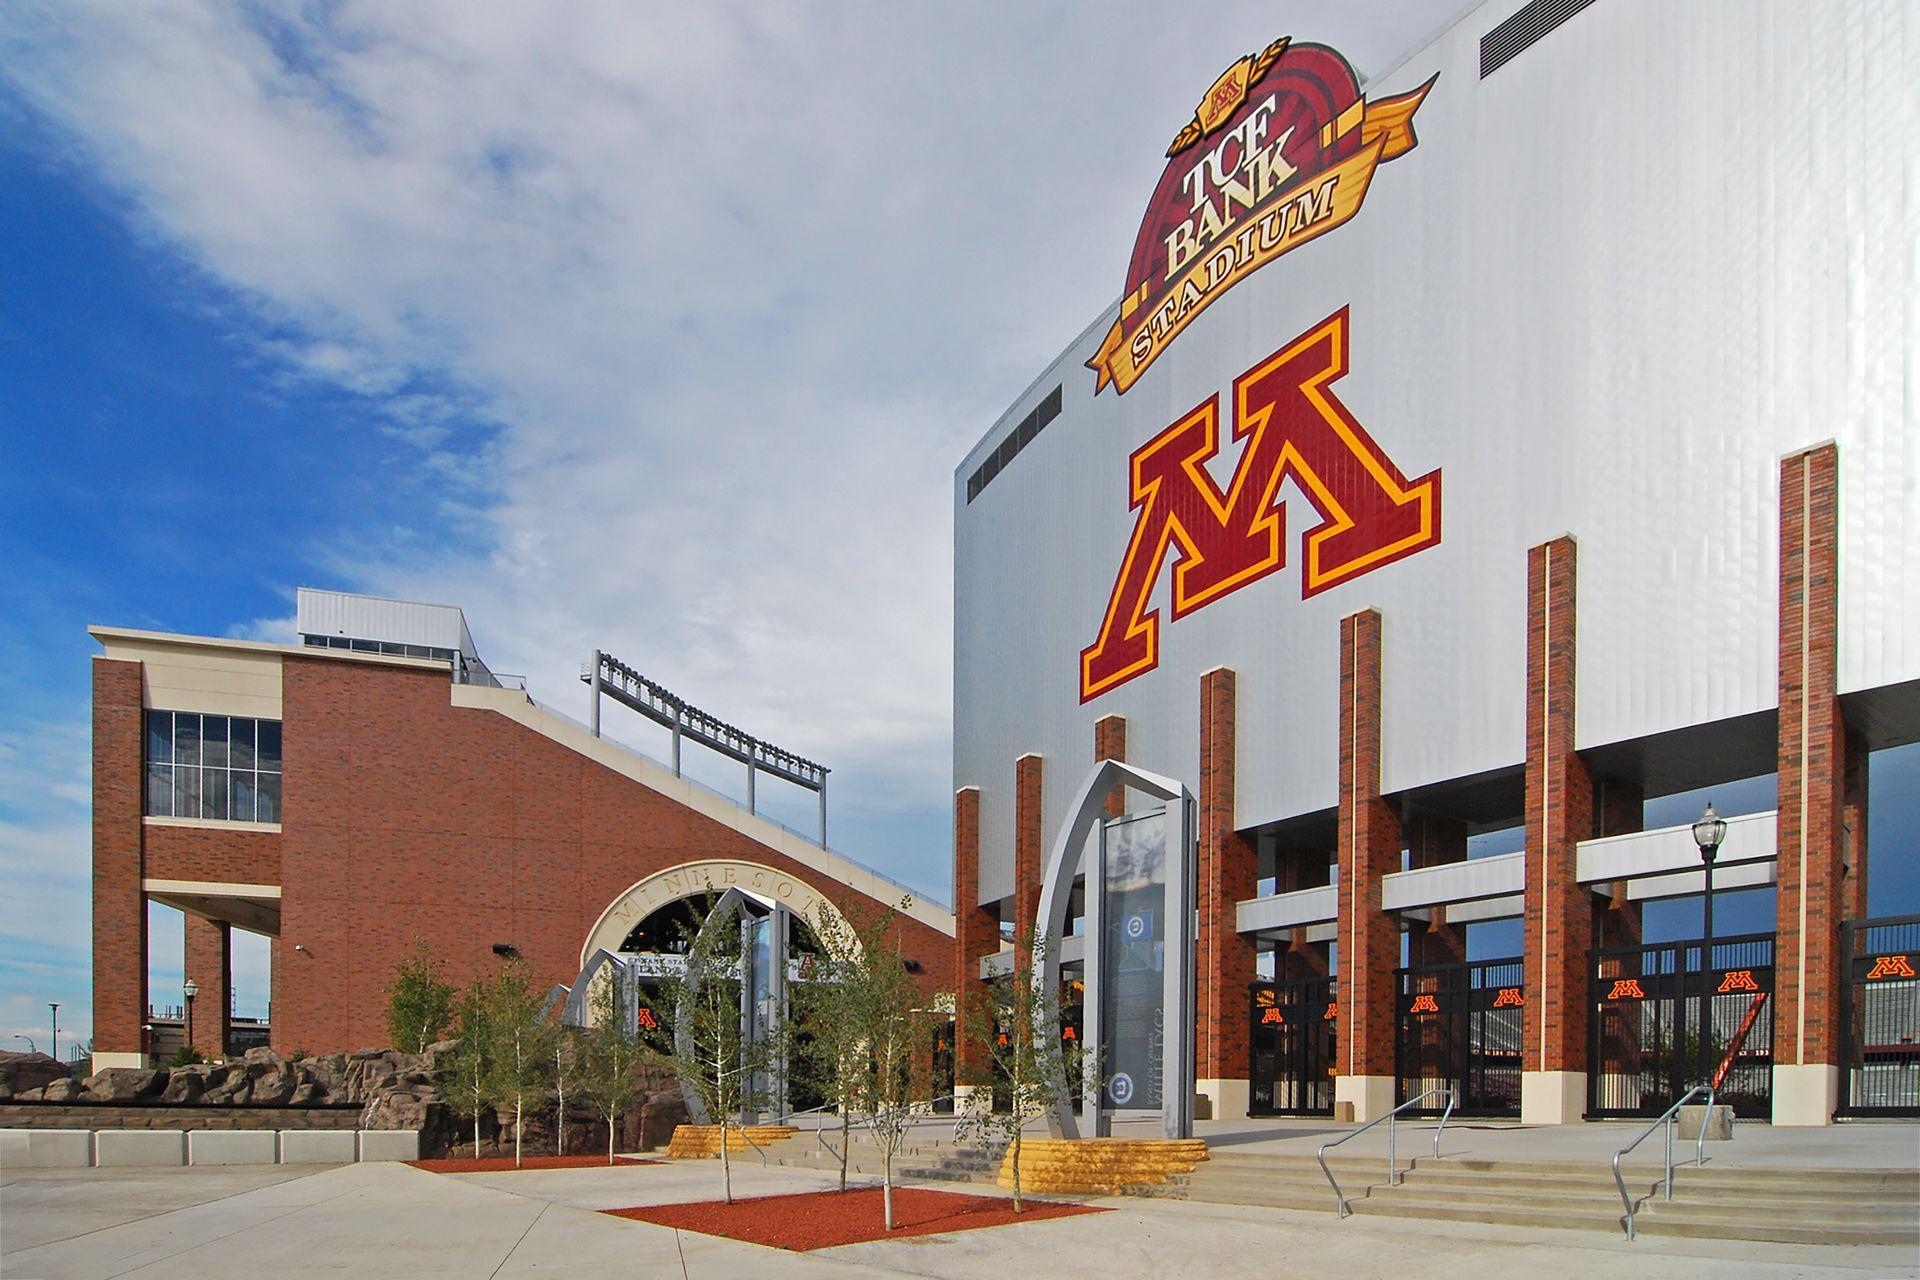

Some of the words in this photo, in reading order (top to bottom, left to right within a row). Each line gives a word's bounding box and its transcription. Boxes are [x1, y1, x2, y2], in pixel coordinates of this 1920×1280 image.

[1182, 93, 1276, 215] TCF
[1164, 125, 1297, 282] BANK
[1130, 178, 1338, 367] STADIUM
[1080, 303, 1442, 706] M
[613, 869, 817, 926] MINNESOT
[1866, 955, 1916, 979] M
[1607, 979, 1645, 999] M
[1717, 970, 1759, 992] M
[1410, 995, 1439, 1013] M
[1493, 988, 1524, 1007] M
[1261, 1008, 1283, 1024] M
